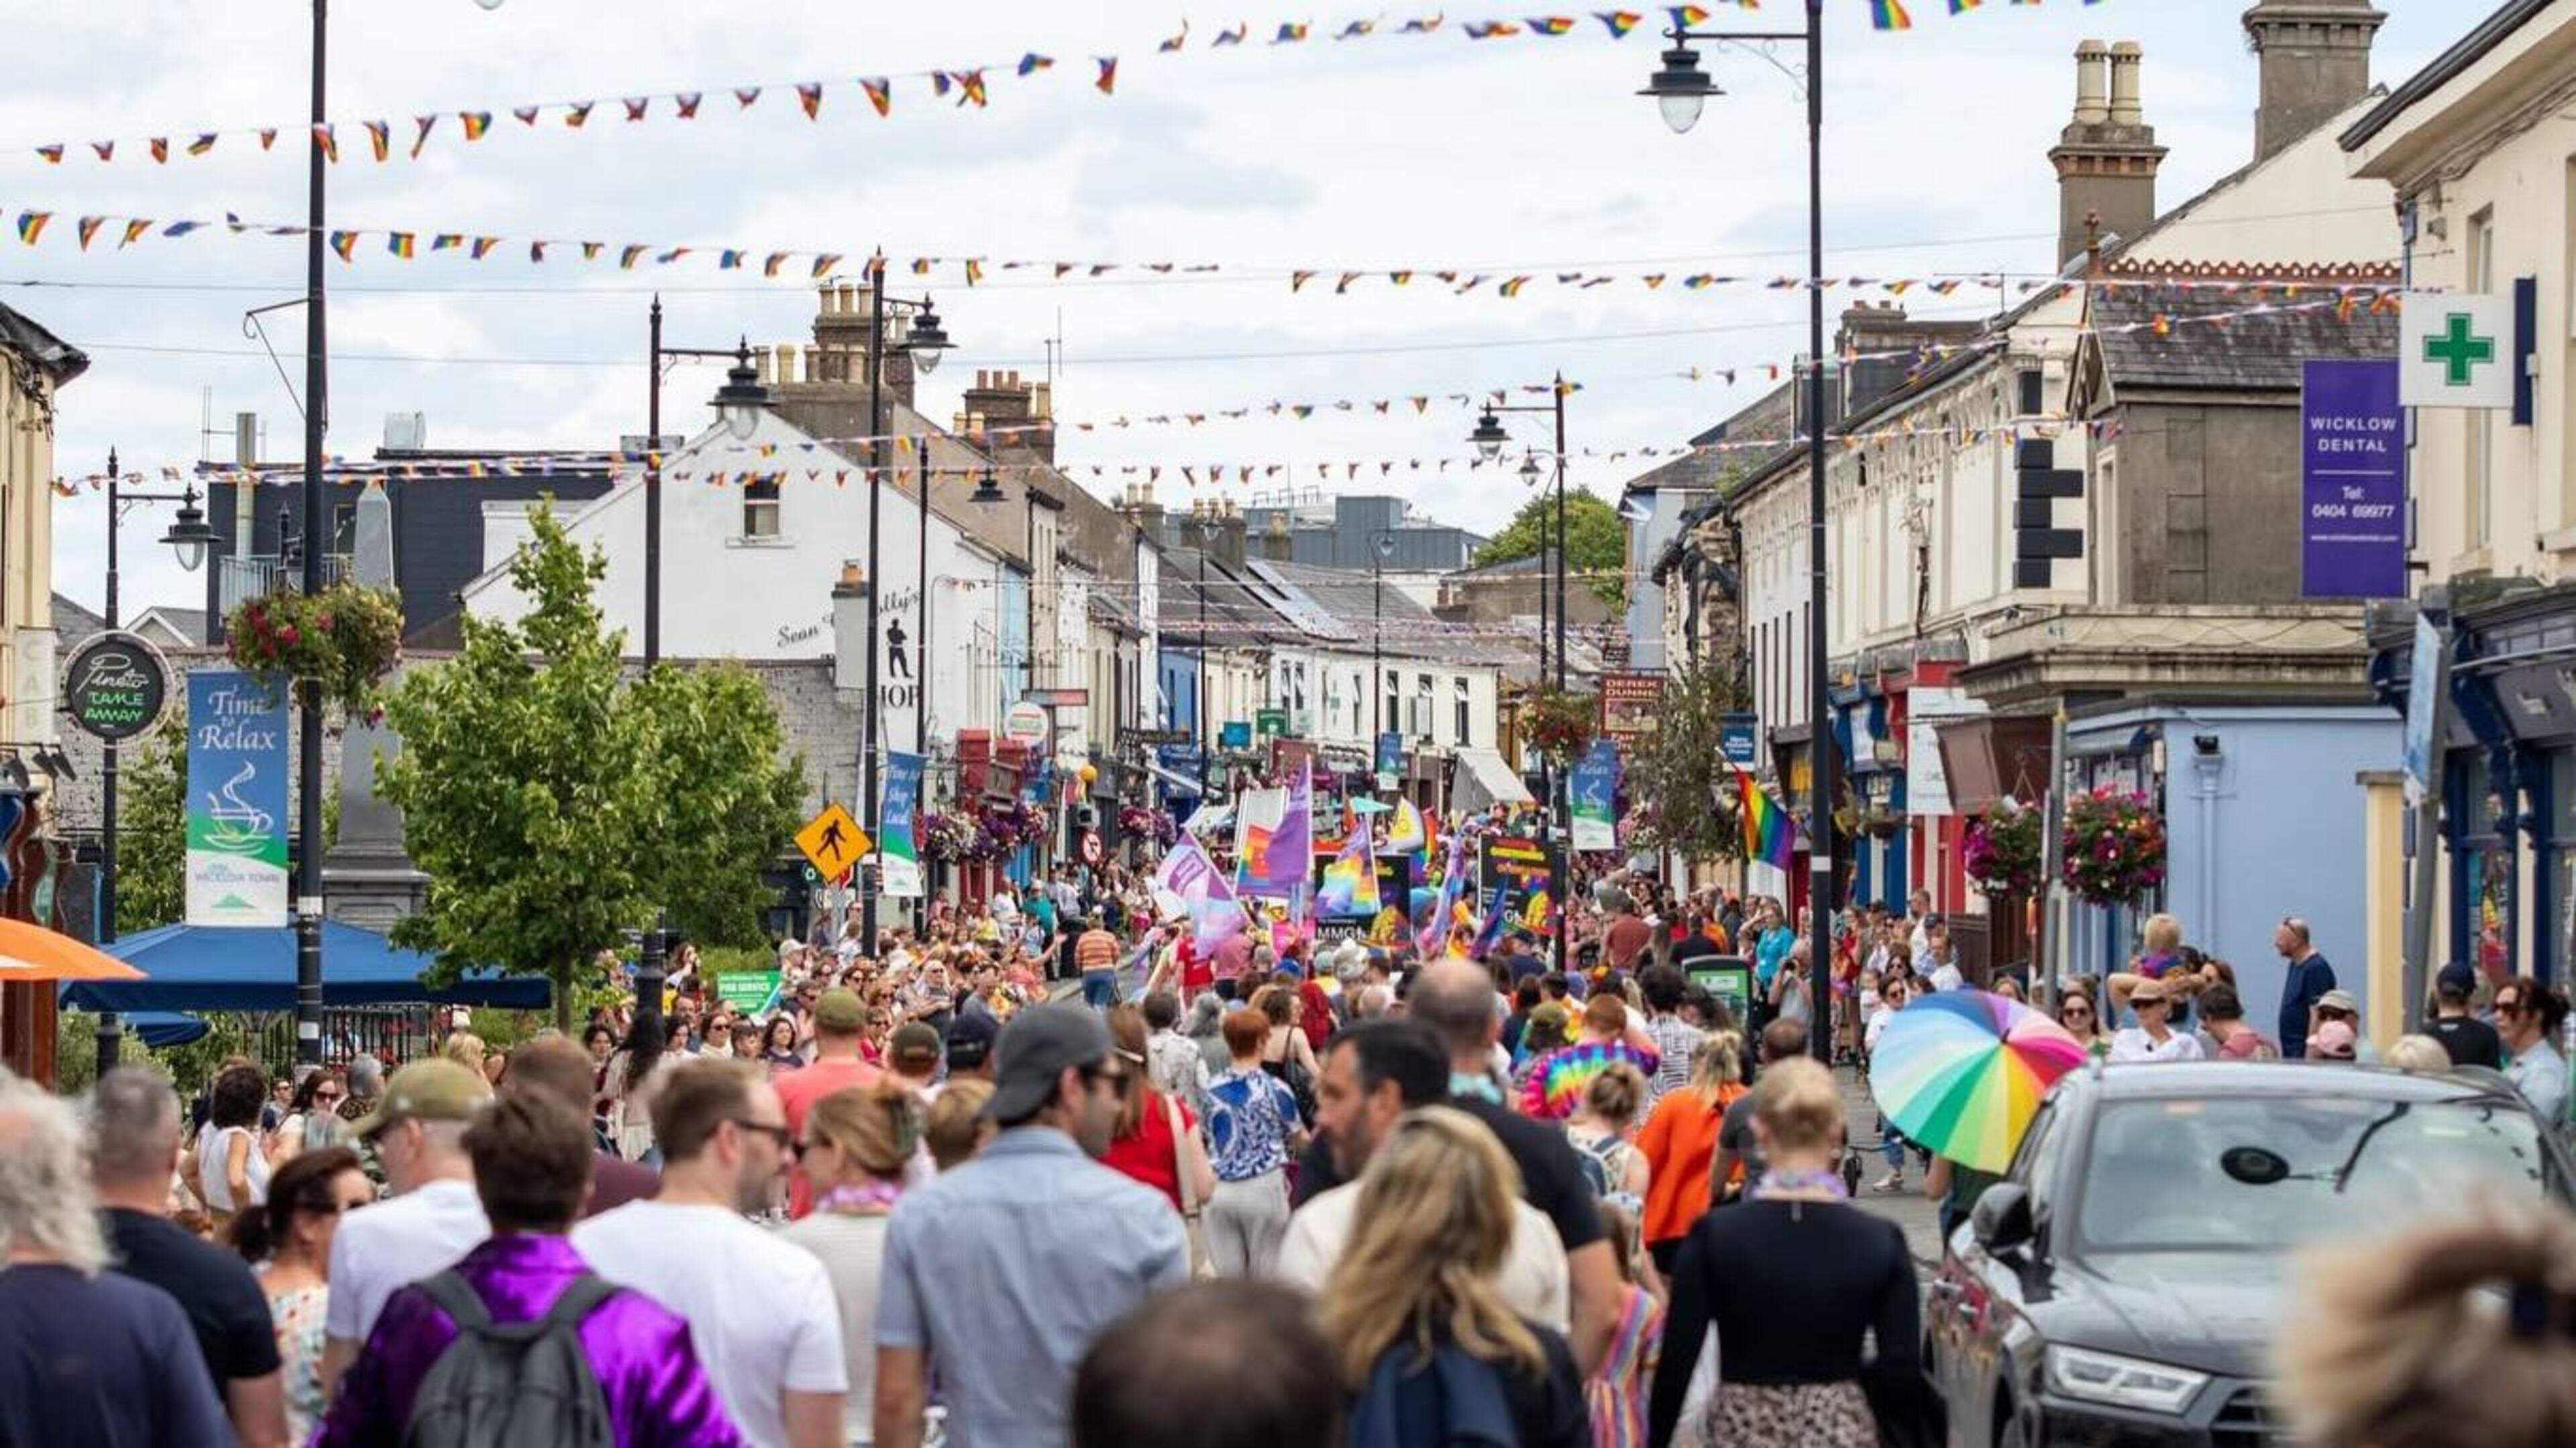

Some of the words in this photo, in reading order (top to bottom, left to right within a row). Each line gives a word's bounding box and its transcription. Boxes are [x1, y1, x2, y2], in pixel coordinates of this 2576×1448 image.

[2310, 417, 2396, 431] WICKLOW
[2318, 439, 2387, 452] DENTAL
[2342, 486, 2365, 500] Tel:
[2312, 504, 2347, 518] 0404
[777, 625, 818, 647] Sean
[88, 692, 144, 706] TAKE
[209, 684, 272, 716] Time
[85, 708, 143, 722] AWAY
[198, 718, 277, 750] Relax
